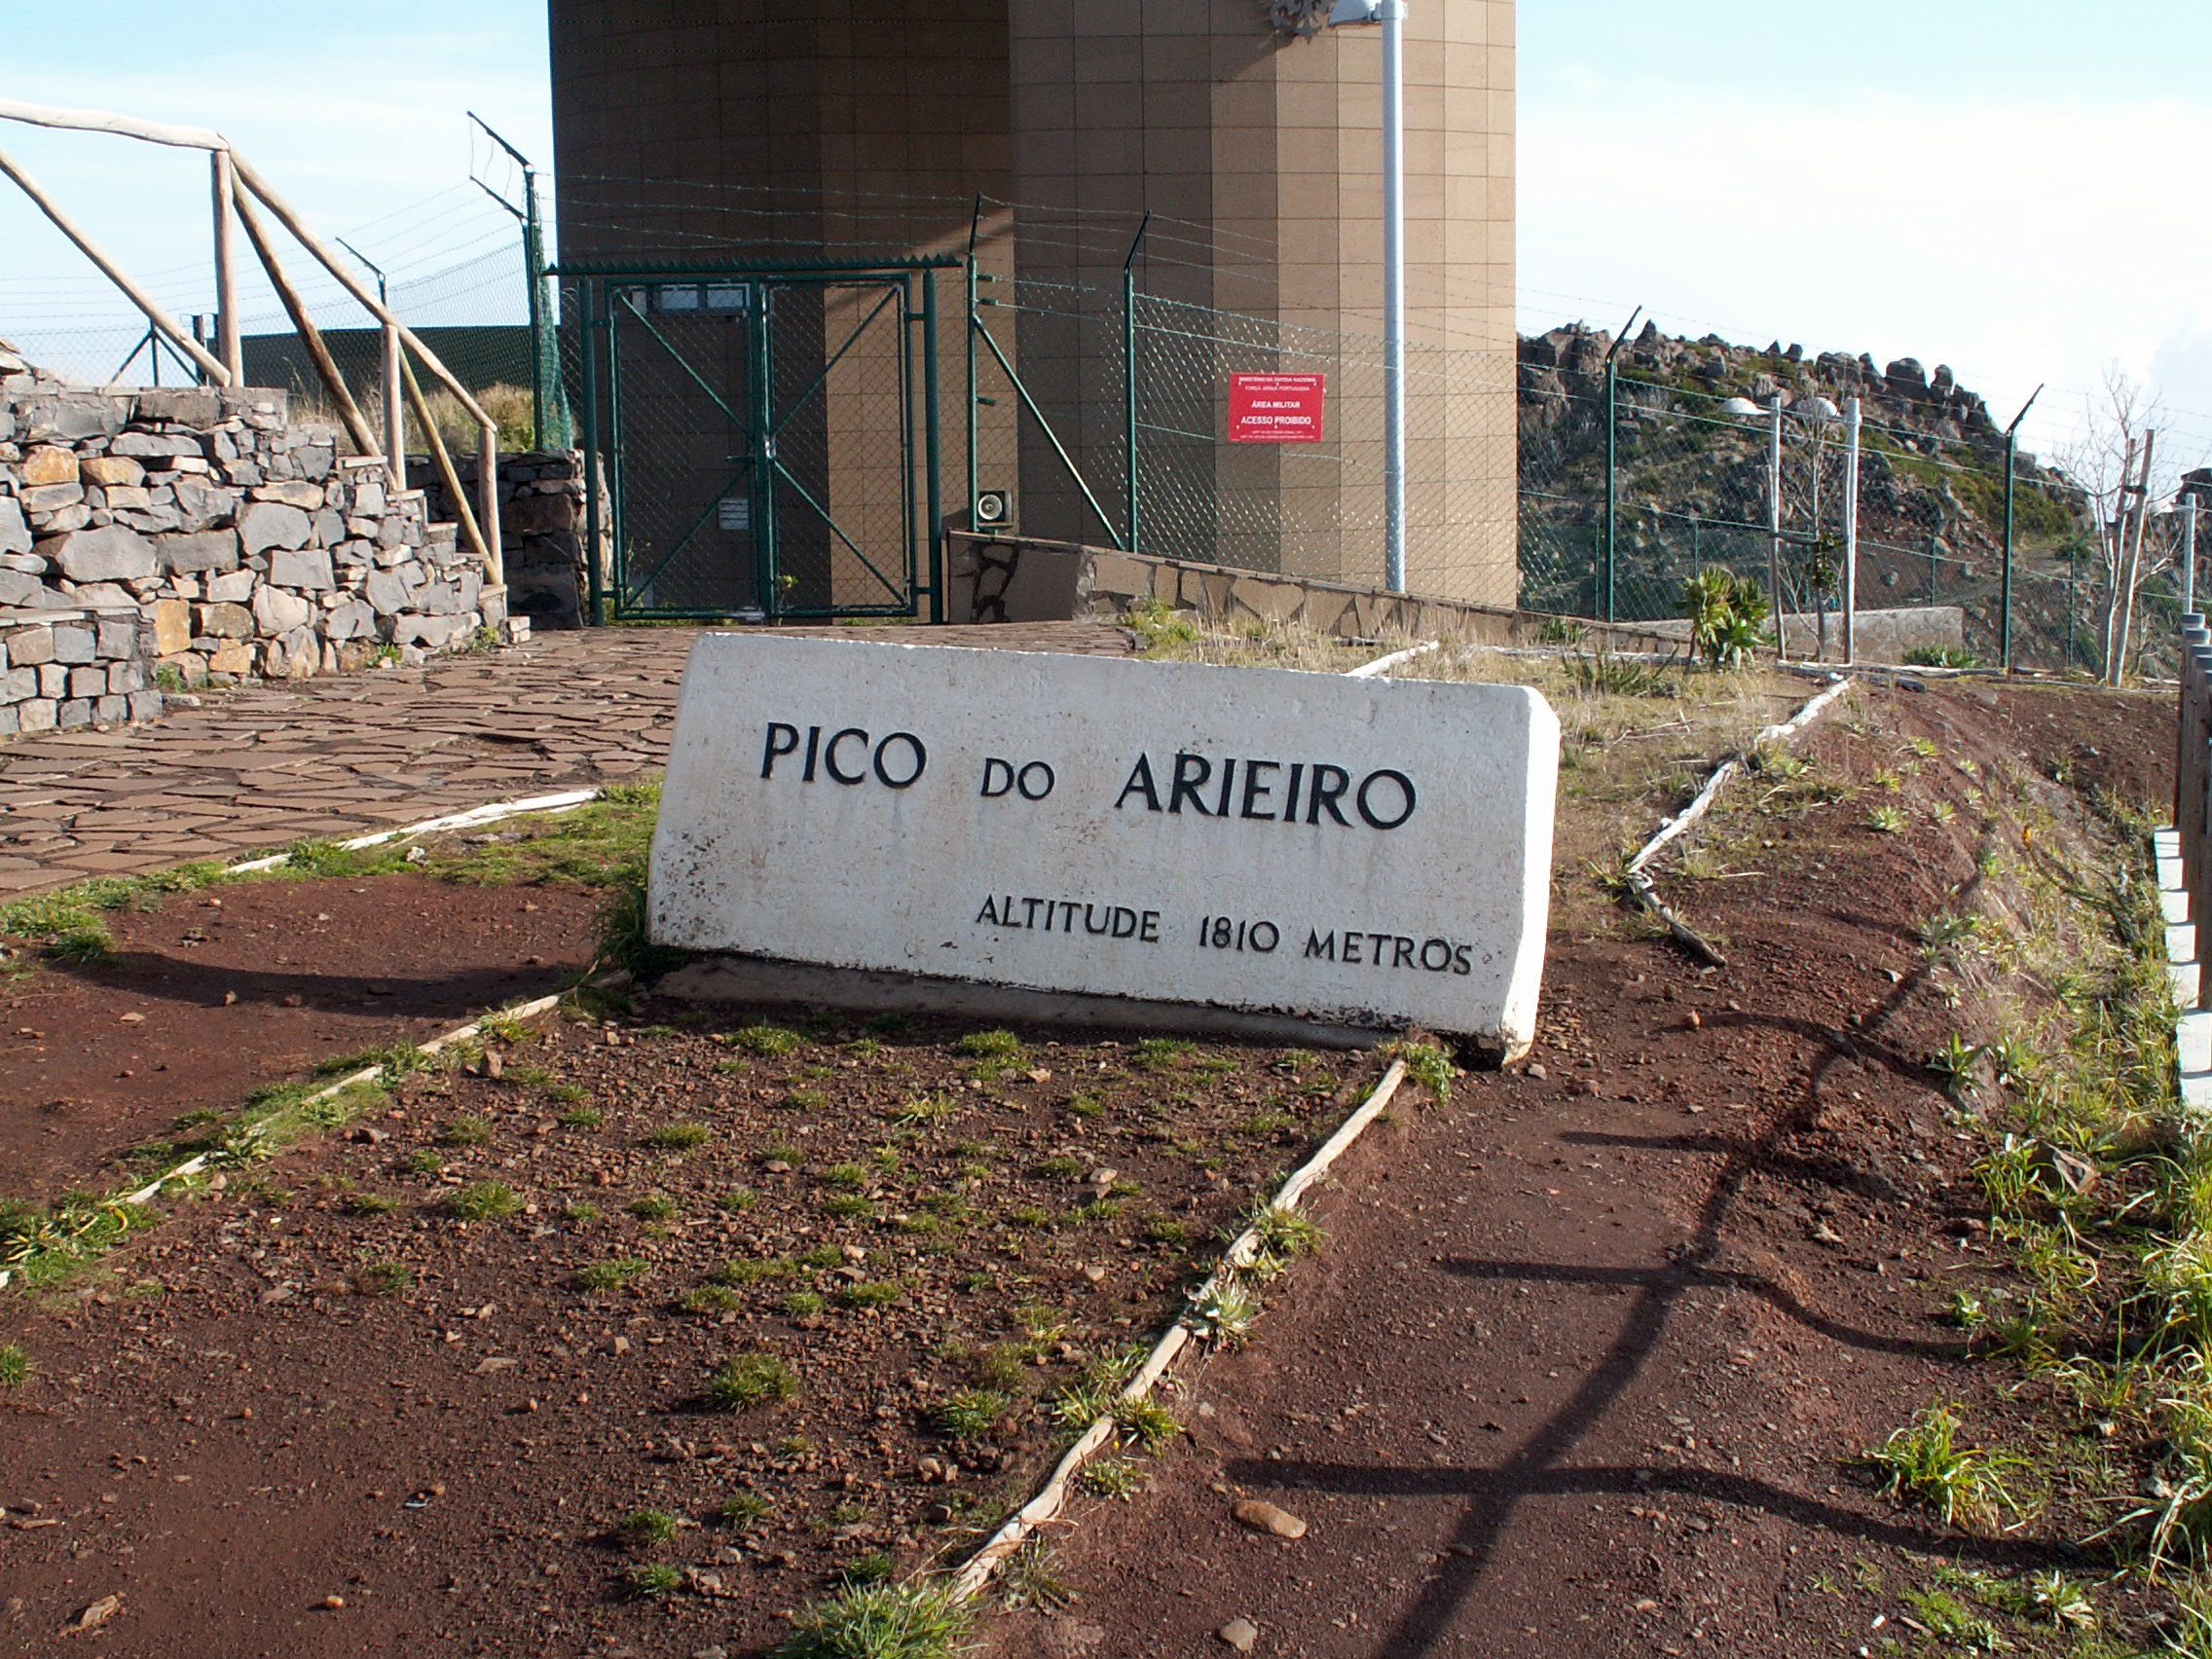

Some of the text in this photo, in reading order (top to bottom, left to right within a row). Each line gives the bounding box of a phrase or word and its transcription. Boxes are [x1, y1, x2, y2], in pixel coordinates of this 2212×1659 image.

[1240, 416, 1312, 424] ACESSO PROIBIDO
[759, 721, 1417, 831] PICO DO ARIEIRO
[975, 893, 1473, 977] ALTITUDE 1810 METROS
